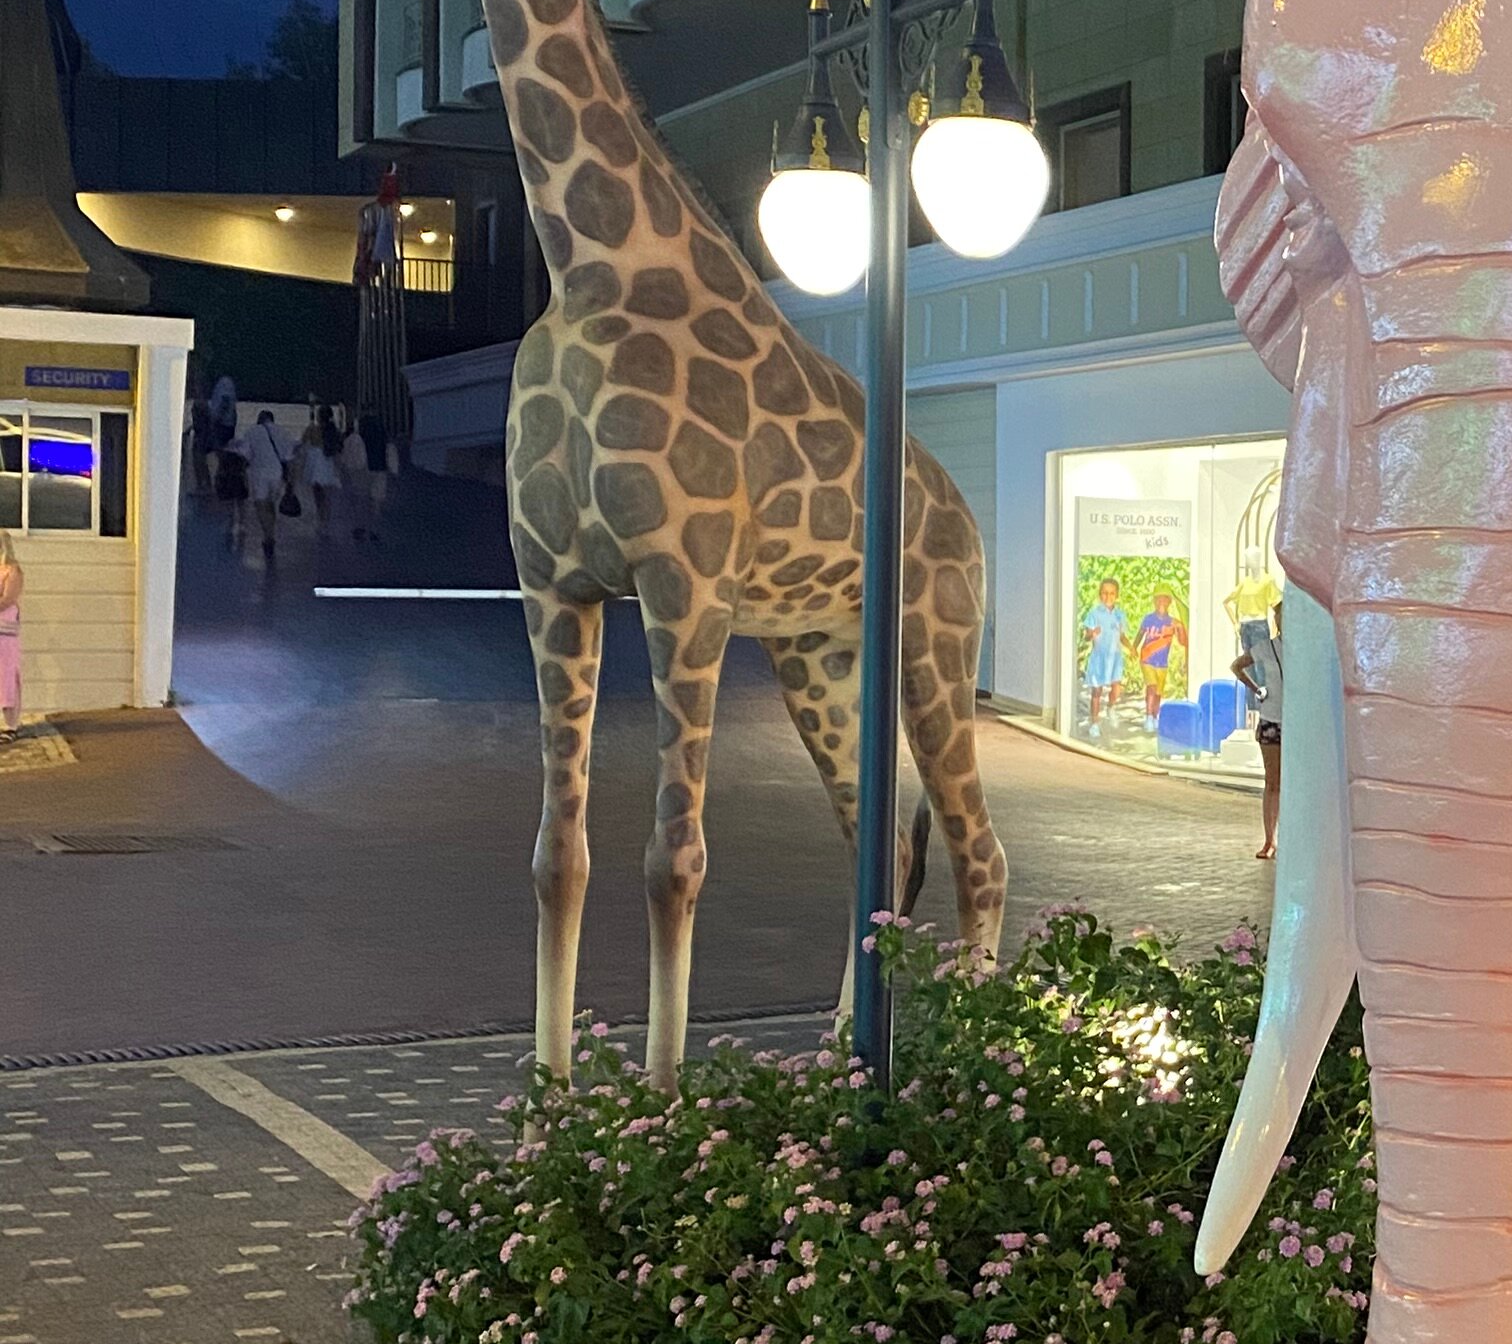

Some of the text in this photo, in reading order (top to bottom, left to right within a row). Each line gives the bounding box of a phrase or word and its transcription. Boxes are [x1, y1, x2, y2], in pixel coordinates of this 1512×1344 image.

[30, 369, 112, 386] SECURITY
[1113, 514, 1145, 526] POLO
[1147, 516, 1182, 528] ASSN.
[1145, 536, 1169, 549] kids
